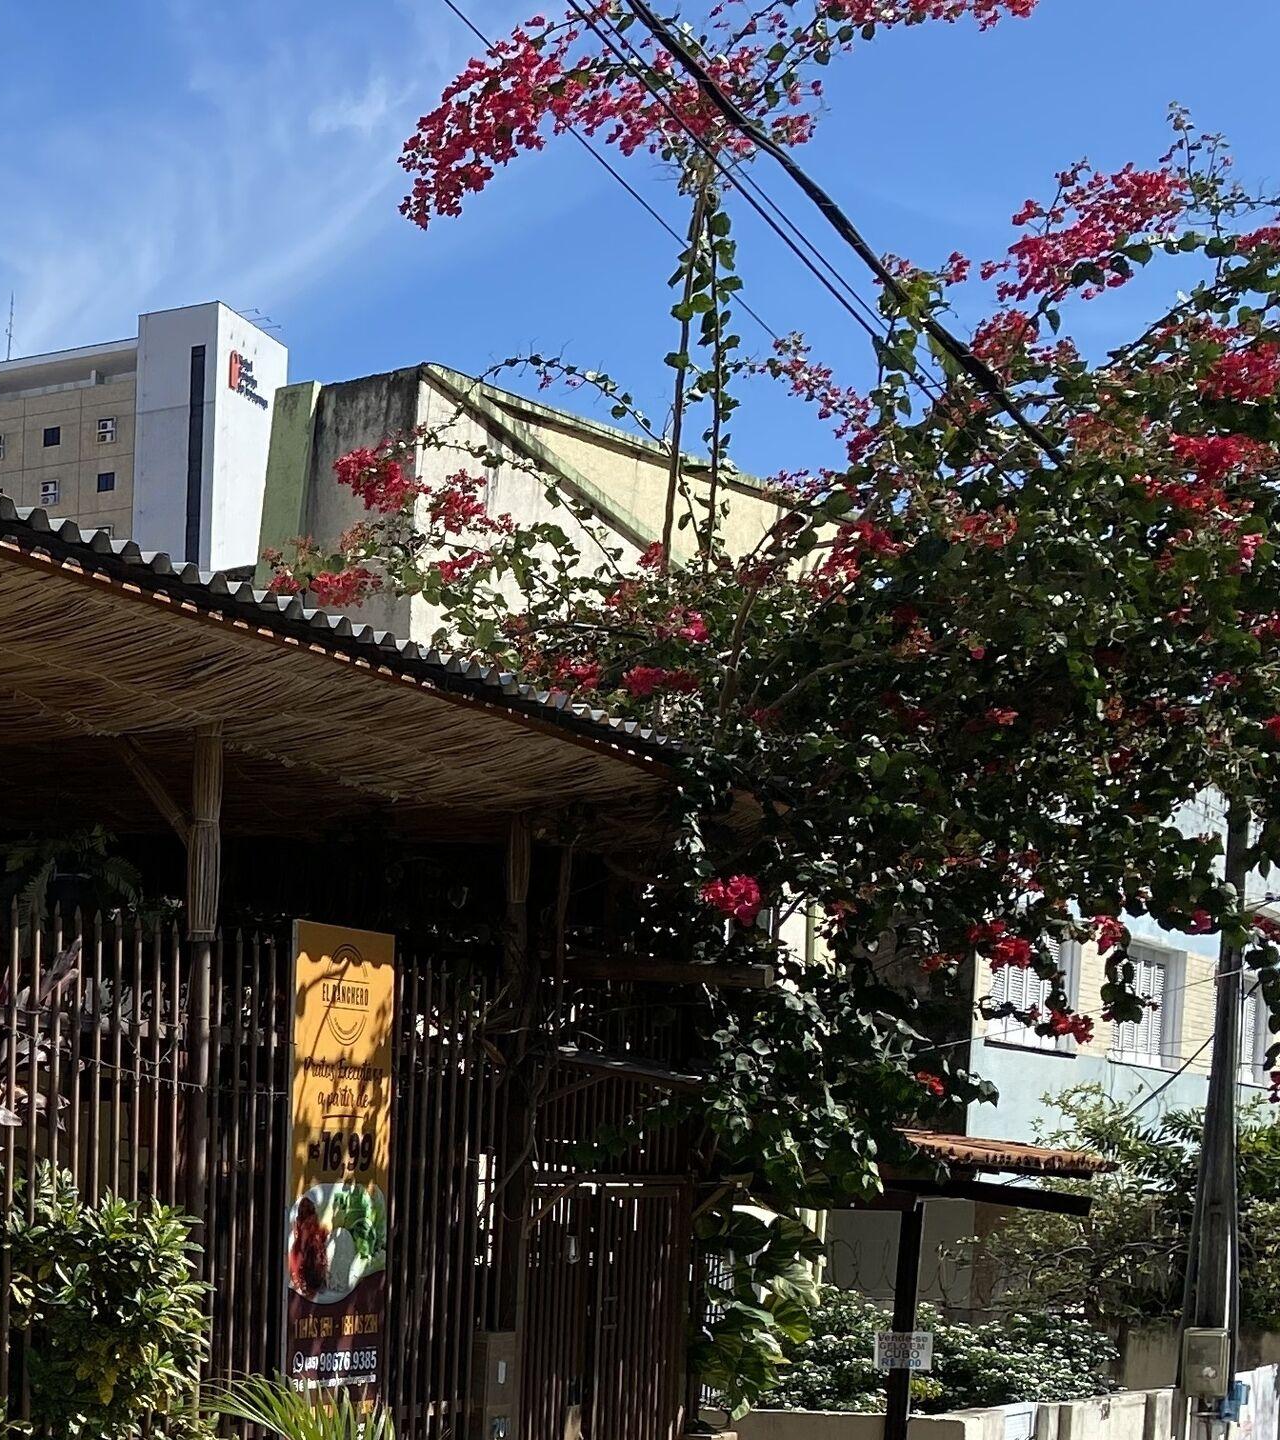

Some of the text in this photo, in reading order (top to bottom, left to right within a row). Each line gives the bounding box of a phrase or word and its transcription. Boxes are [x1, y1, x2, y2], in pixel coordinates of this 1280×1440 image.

[322, 982, 369, 1006] EL RANCHERO
[303, 1056, 335, 1082] Pratos
[321, 1131, 373, 1179] 16,99
[319, 1350, 377, 1372] 98676.9385
[884, 1349, 920, 1359] CUBO
